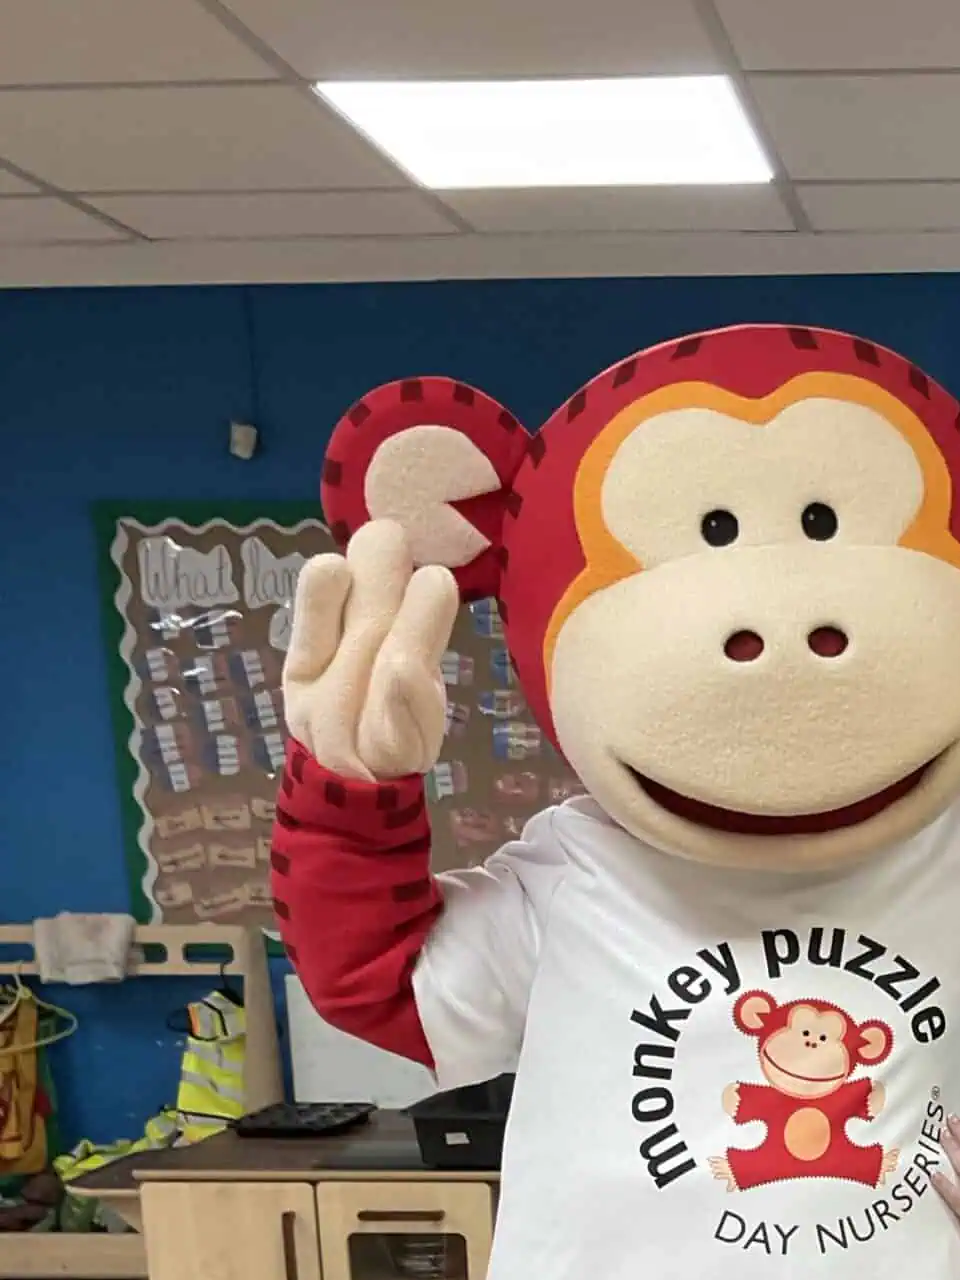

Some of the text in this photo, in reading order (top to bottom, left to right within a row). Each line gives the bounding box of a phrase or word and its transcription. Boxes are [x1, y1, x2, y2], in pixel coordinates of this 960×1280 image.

[142, 541, 236, 602] What
[629, 926, 946, 1190] monkey puzzle
[714, 1209, 799, 1255] DAY
